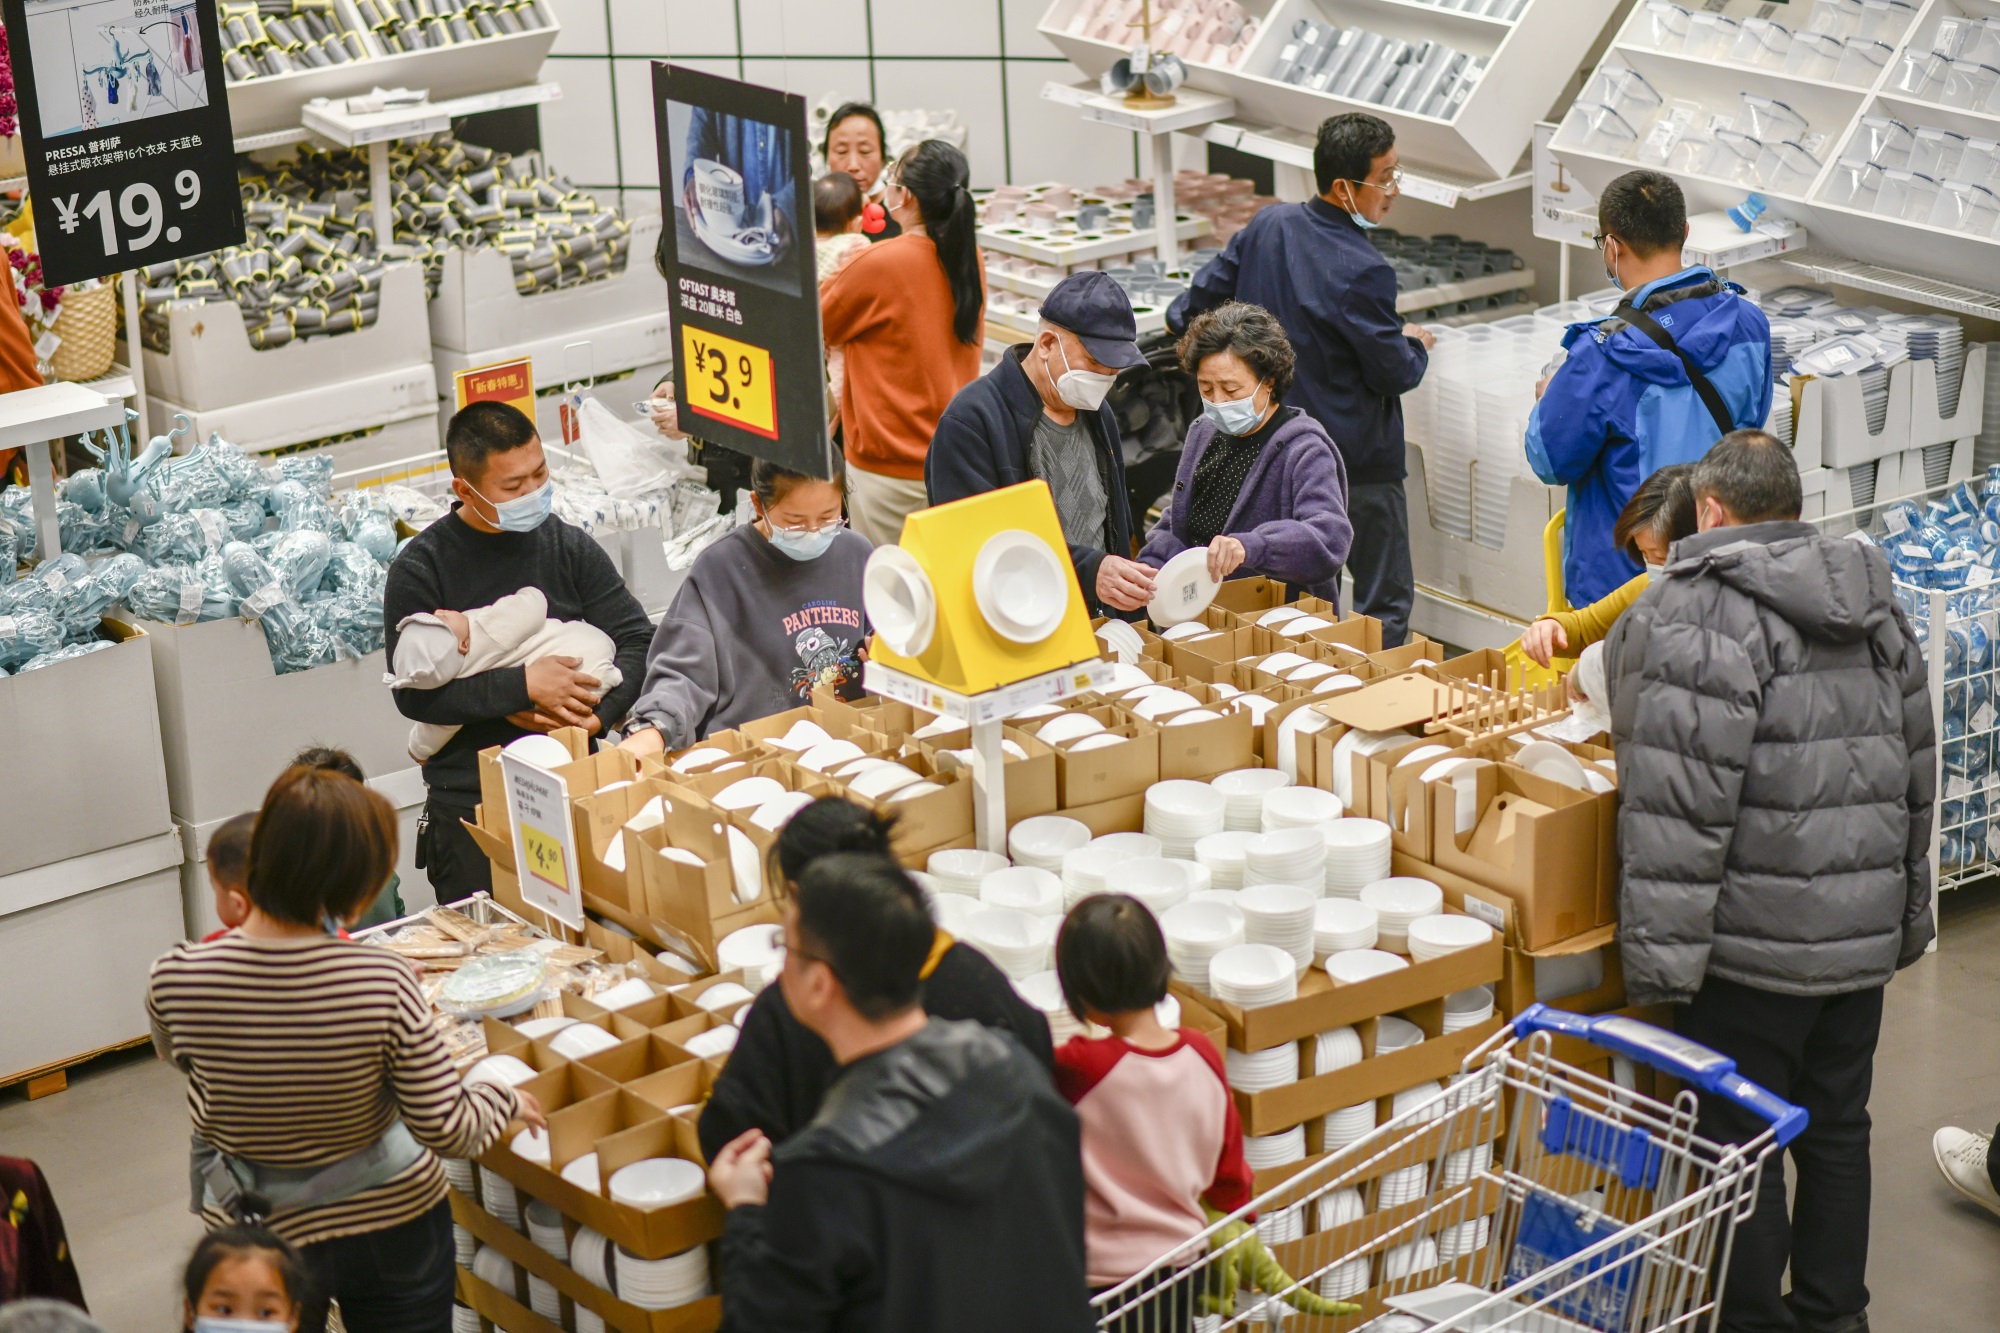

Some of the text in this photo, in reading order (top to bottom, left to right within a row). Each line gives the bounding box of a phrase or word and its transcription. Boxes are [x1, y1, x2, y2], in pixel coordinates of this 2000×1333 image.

[134, 4, 169, 18] 经久耐用
[45, 136, 122, 162] PRESSA 普利萨
[47, 134, 203, 177] 悬挂式晾衣架带16个衣夹 天蓝色
[679, 278, 736, 306] OFTAST 奥夫塔
[680, 293, 743, 326] 深盘 20厘米 白色
[782, 606, 859, 635] PANTHERS
